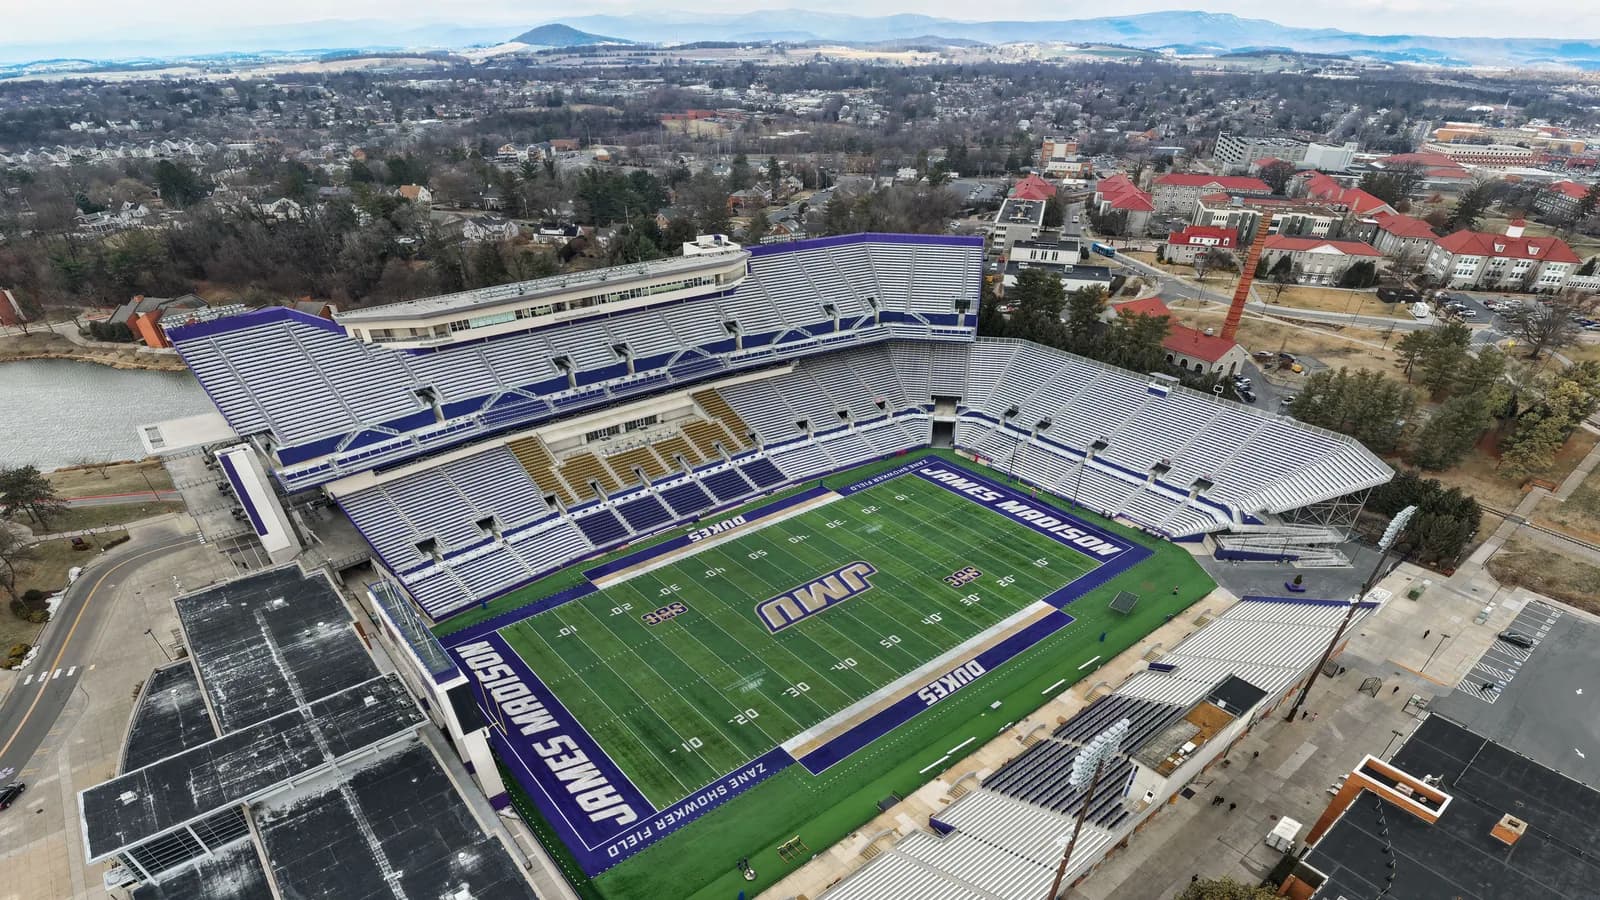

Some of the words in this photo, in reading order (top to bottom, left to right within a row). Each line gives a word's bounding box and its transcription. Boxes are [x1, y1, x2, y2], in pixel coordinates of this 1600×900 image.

[908, 459, 929, 469] ZANE
[873, 466, 909, 482] SHOWKER
[849, 480, 873, 491] FIELD
[920, 468, 1005, 502] JAMES
[995, 499, 1123, 556] MADISON
[687, 515, 747, 542] DUKES
[826, 520, 843, 528] 30
[788, 535, 807, 543] 40
[748, 550, 768, 560] 50
[1033, 558, 1048, 567] 10
[705, 567, 726, 577] 40
[996, 576, 1015, 587] 20
[660, 584, 682, 595] 30
[756, 562, 875, 632] JMU
[960, 594, 980, 606] 30
[611, 603, 633, 615] 20
[921, 614, 942, 624] 40
[560, 625, 577, 636] 10
[880, 635, 901, 648] 50
[835, 657, 857, 670] 40
[455, 640, 560, 736] MADISON
[917, 659, 986, 706] DUKES
[786, 682, 810, 697] 30
[734, 708, 759, 725] 20
[681, 736, 703, 752] 10
[532, 734, 638, 826] JAMES
[728, 762, 767, 789] ZANE
[654, 786, 728, 831] SHOWKER
[607, 826, 653, 857] FIELD
